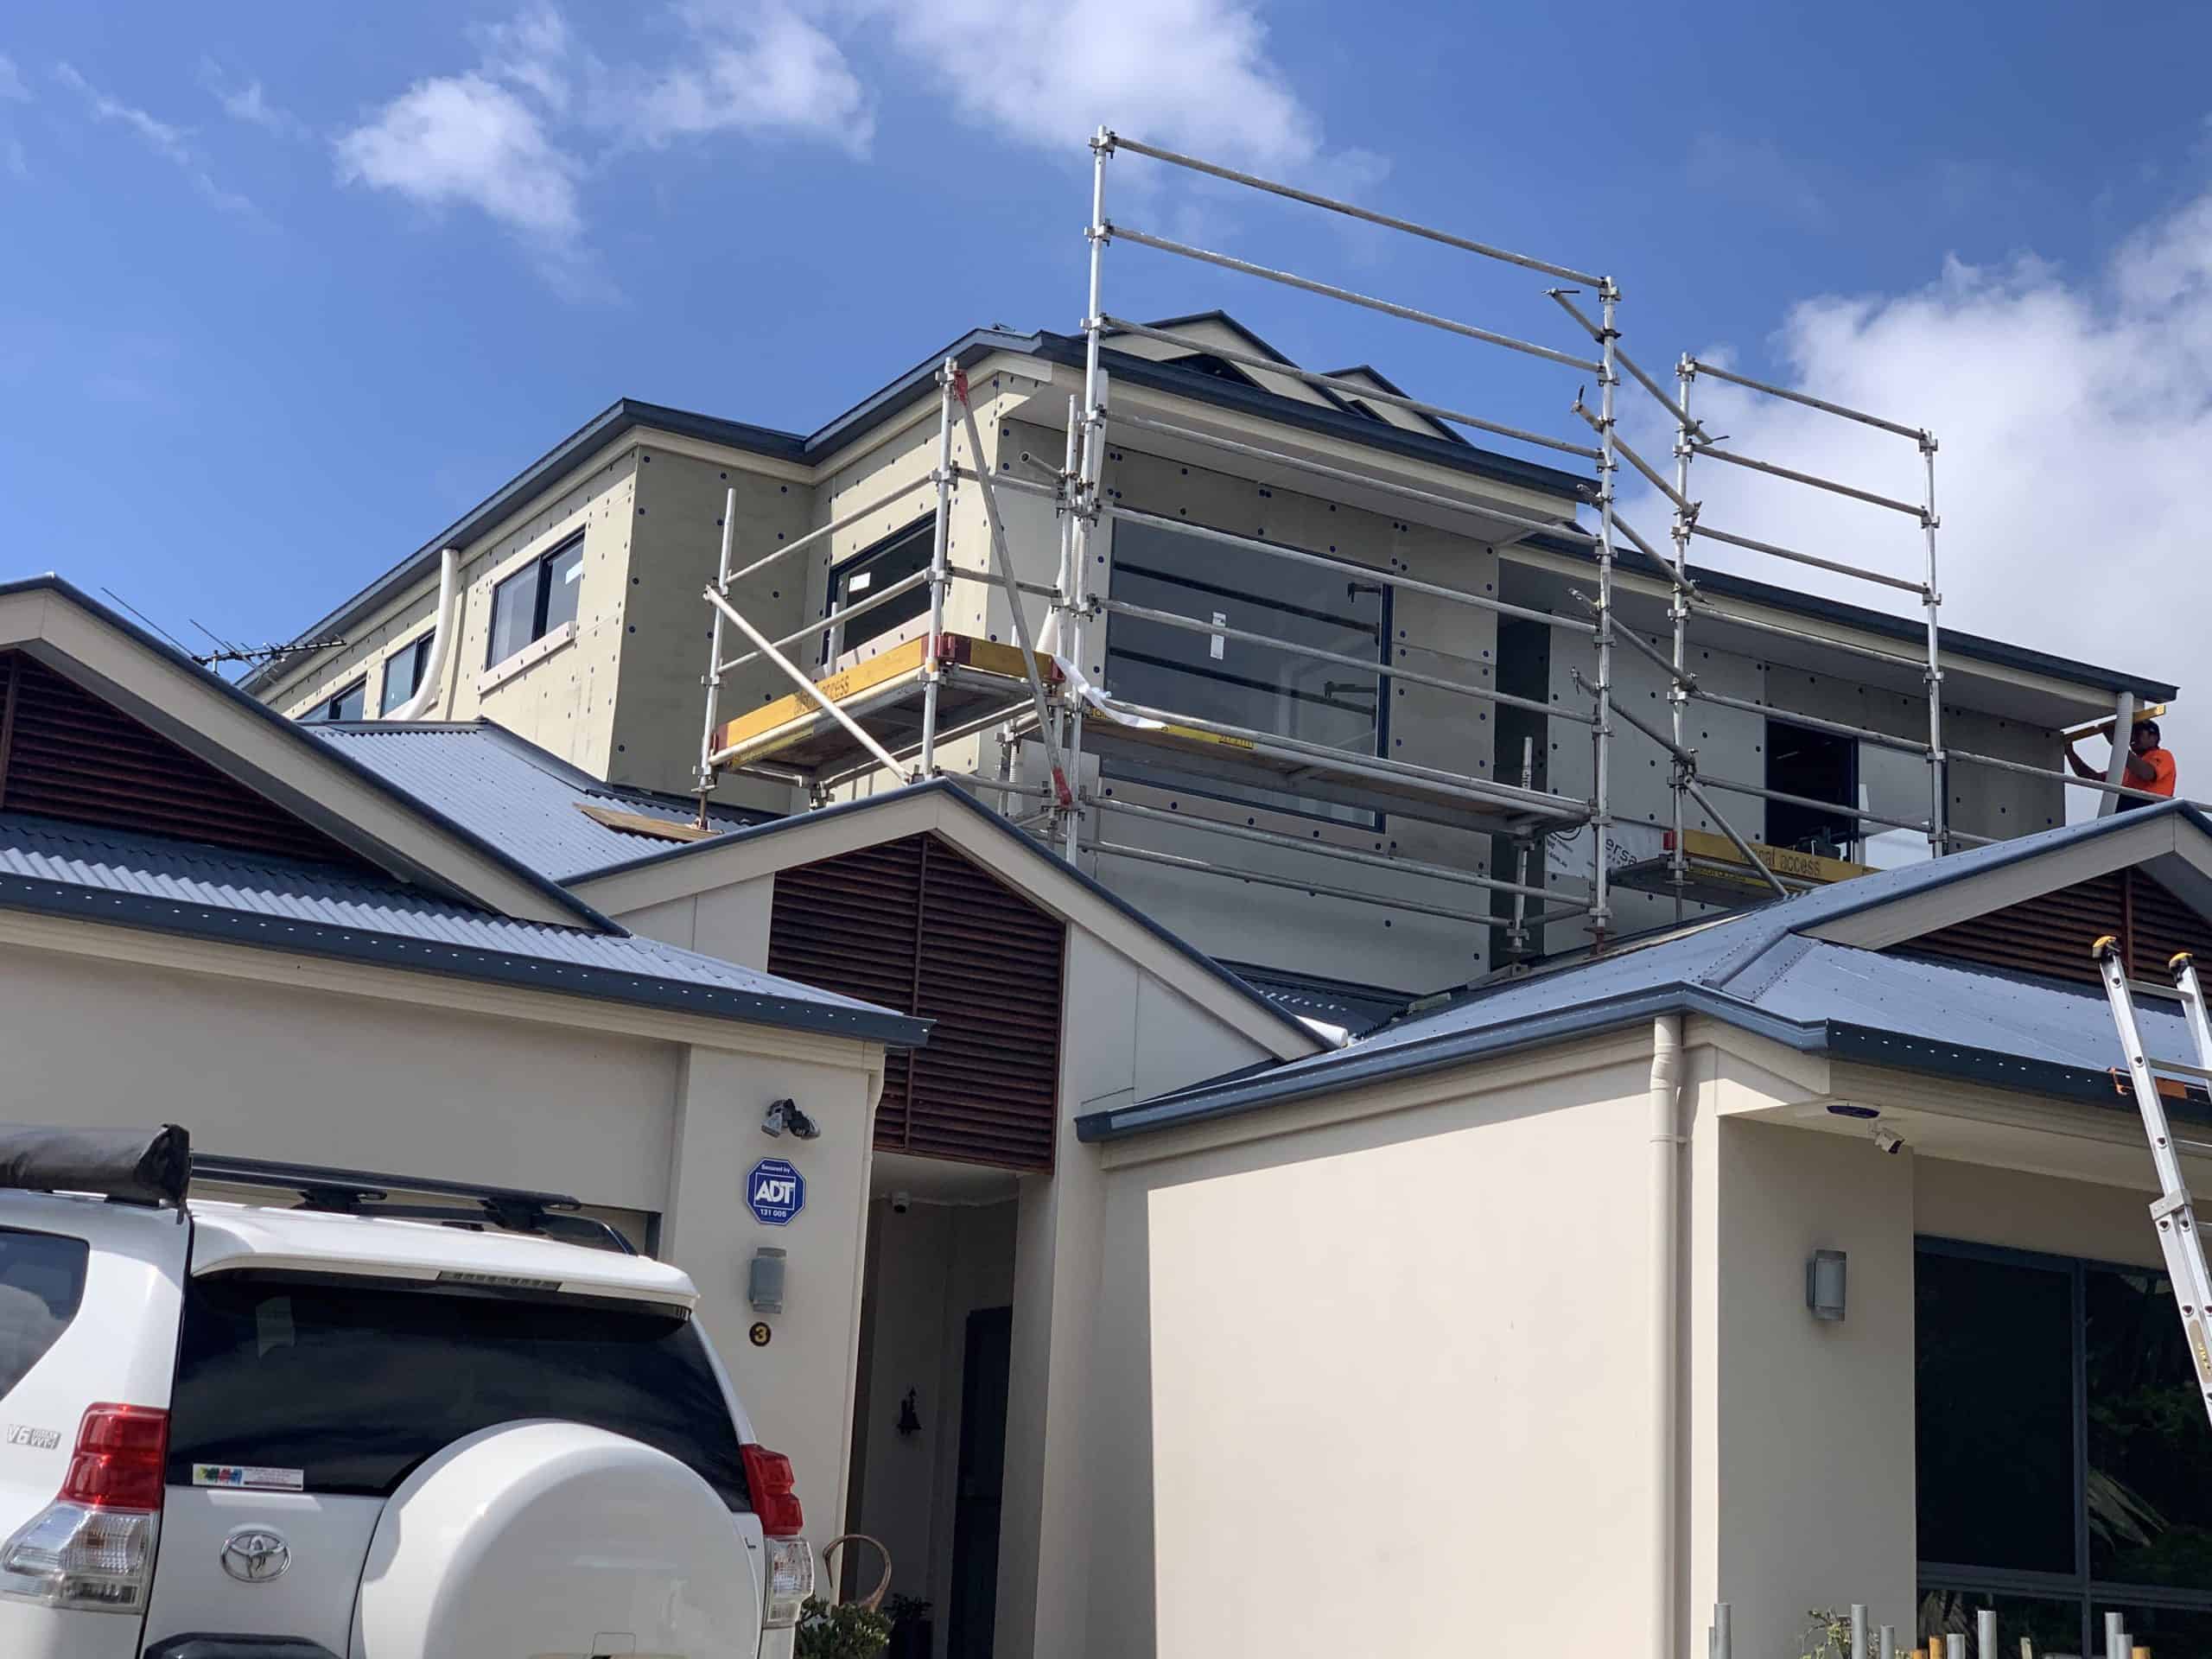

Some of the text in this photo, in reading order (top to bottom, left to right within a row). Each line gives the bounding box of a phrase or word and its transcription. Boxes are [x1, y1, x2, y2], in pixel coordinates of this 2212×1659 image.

[1605, 838, 1638, 865] ersa
[1781, 853, 1821, 874] access
[756, 1179, 795, 1204] ADT
[754, 1325, 767, 1343] 3
[8, 1425, 31, 1445] V6
